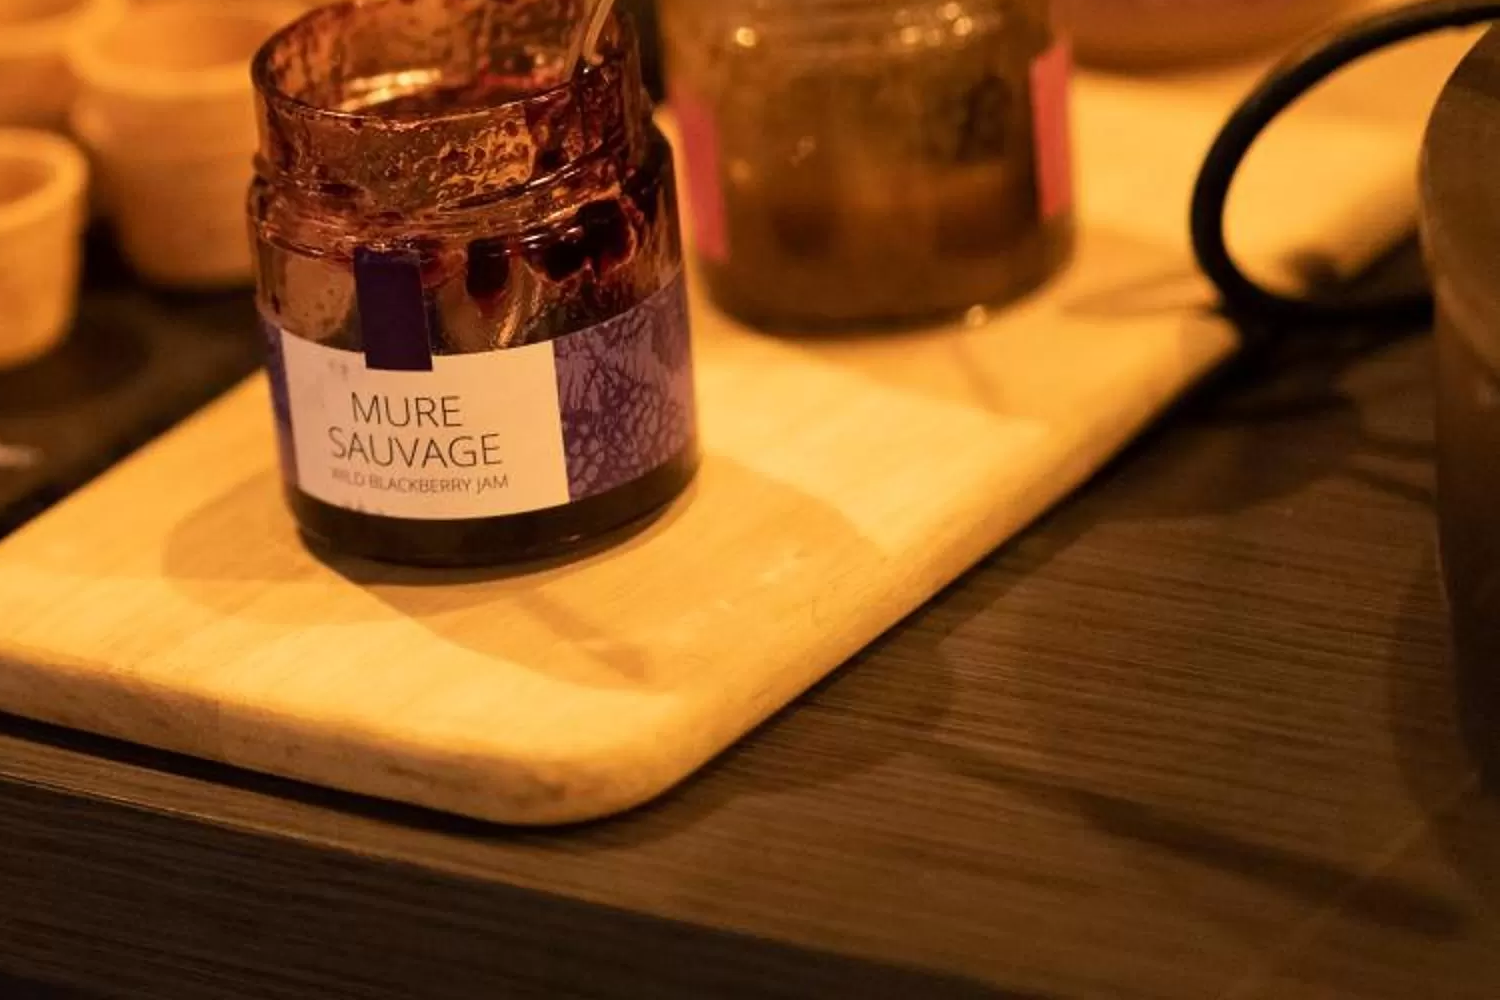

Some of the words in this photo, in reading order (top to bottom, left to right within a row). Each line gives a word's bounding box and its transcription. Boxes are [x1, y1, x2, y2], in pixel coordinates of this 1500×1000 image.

[350, 391, 463, 428] MURE
[327, 425, 504, 469] SAUVAGE
[369, 473, 472, 494] BLACKBERRY
[475, 472, 509, 494] JAM
